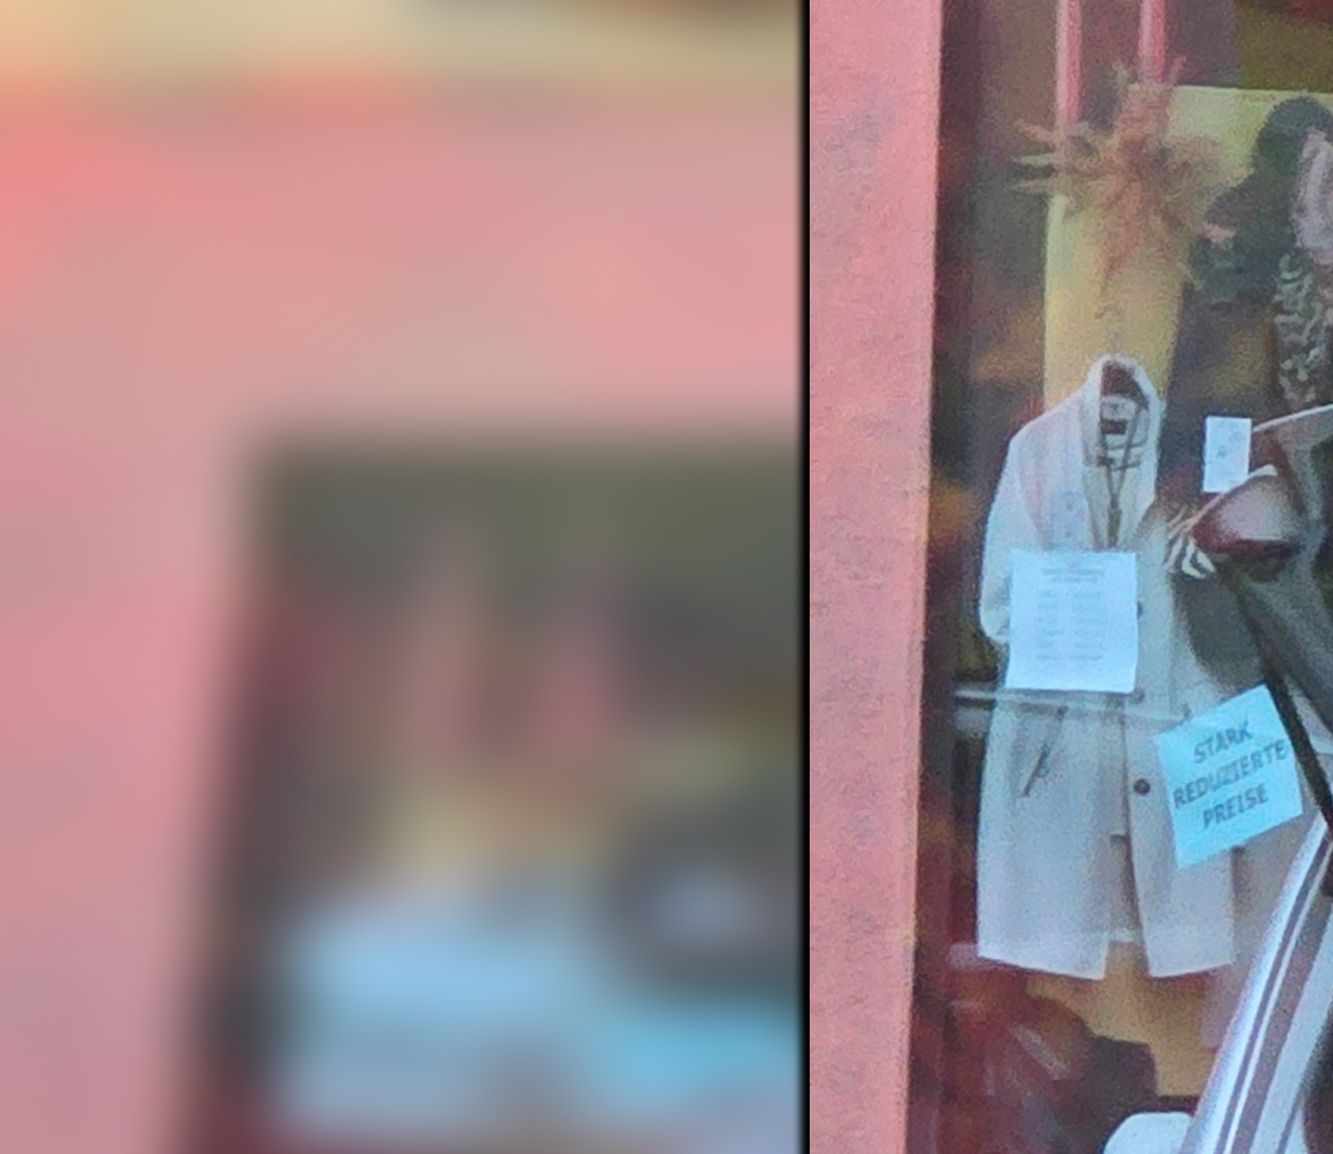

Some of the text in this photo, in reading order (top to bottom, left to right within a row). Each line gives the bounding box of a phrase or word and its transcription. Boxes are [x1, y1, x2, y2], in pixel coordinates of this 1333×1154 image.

[1193, 719, 1253, 764] STARK
[1173, 738, 1288, 809] REDUZIERTE
[1203, 783, 1269, 829] PREISE
